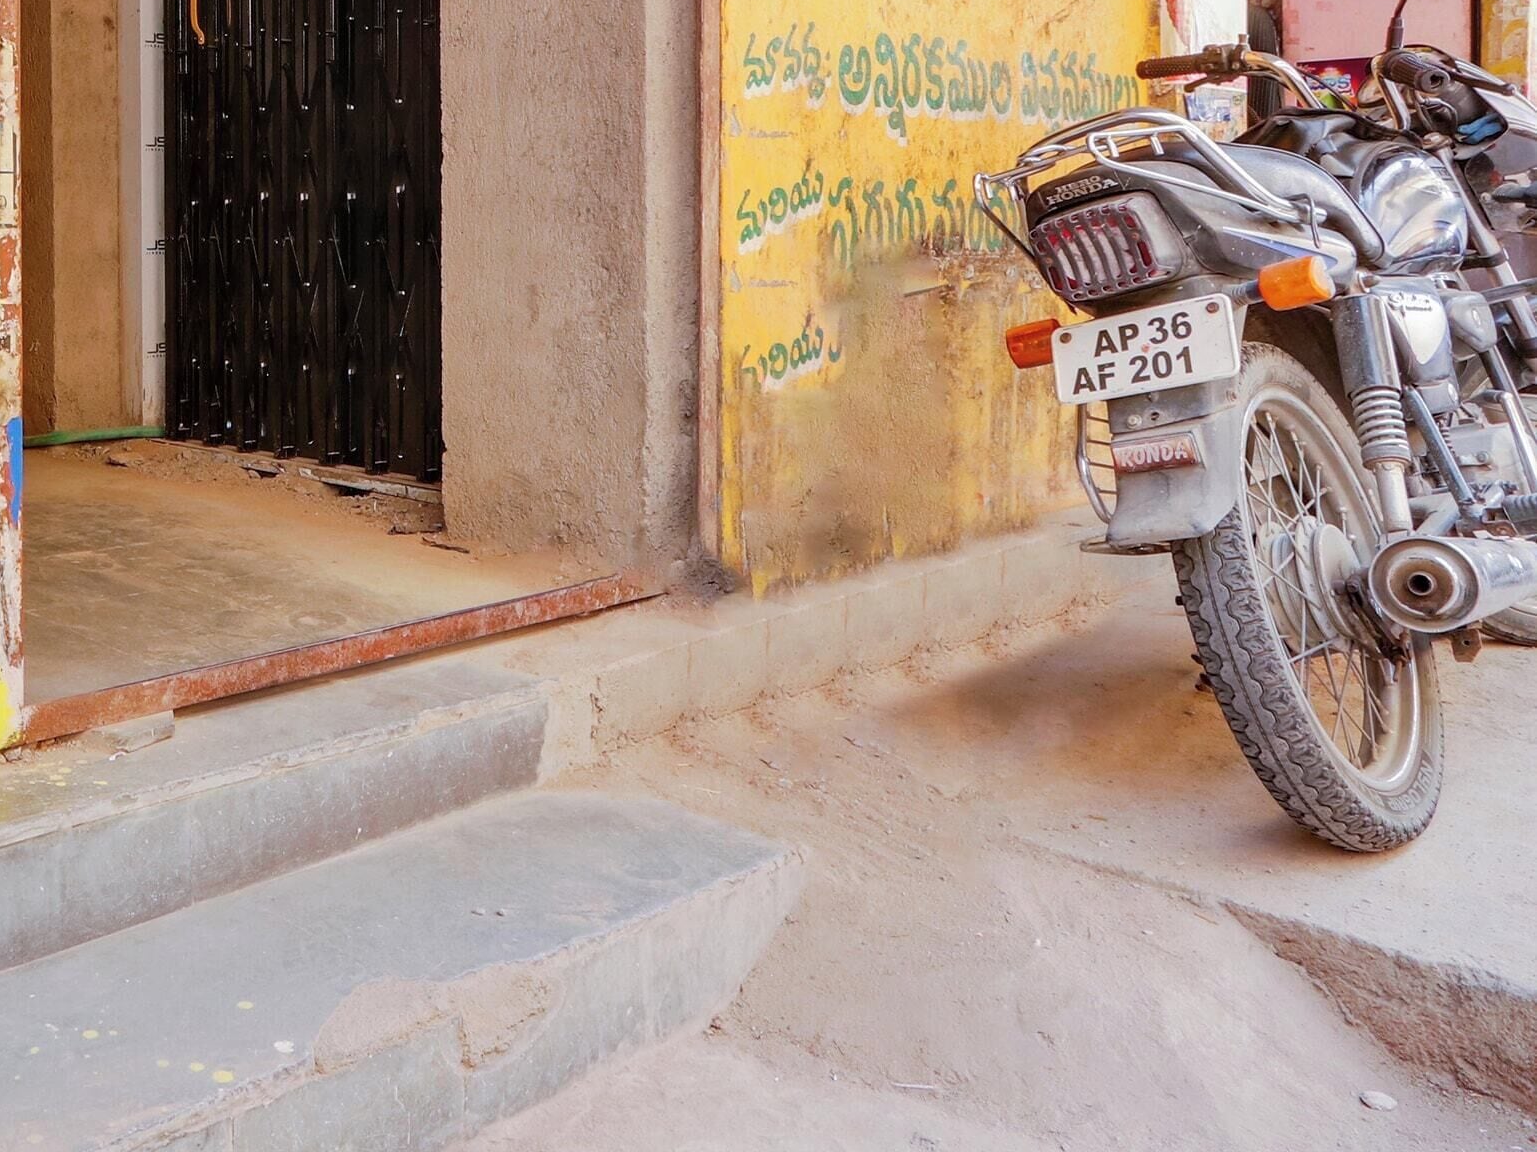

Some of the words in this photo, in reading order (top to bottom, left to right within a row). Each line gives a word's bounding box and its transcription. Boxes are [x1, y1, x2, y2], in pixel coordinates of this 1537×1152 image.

[1046, 178, 1119, 205] HONDA
[1055, 175, 1102, 193] HERO
[1094, 323, 1141, 358] AP
[1147, 310, 1193, 345] 36
[1071, 362, 1117, 396] AF
[1128, 346, 1194, 384] 201
